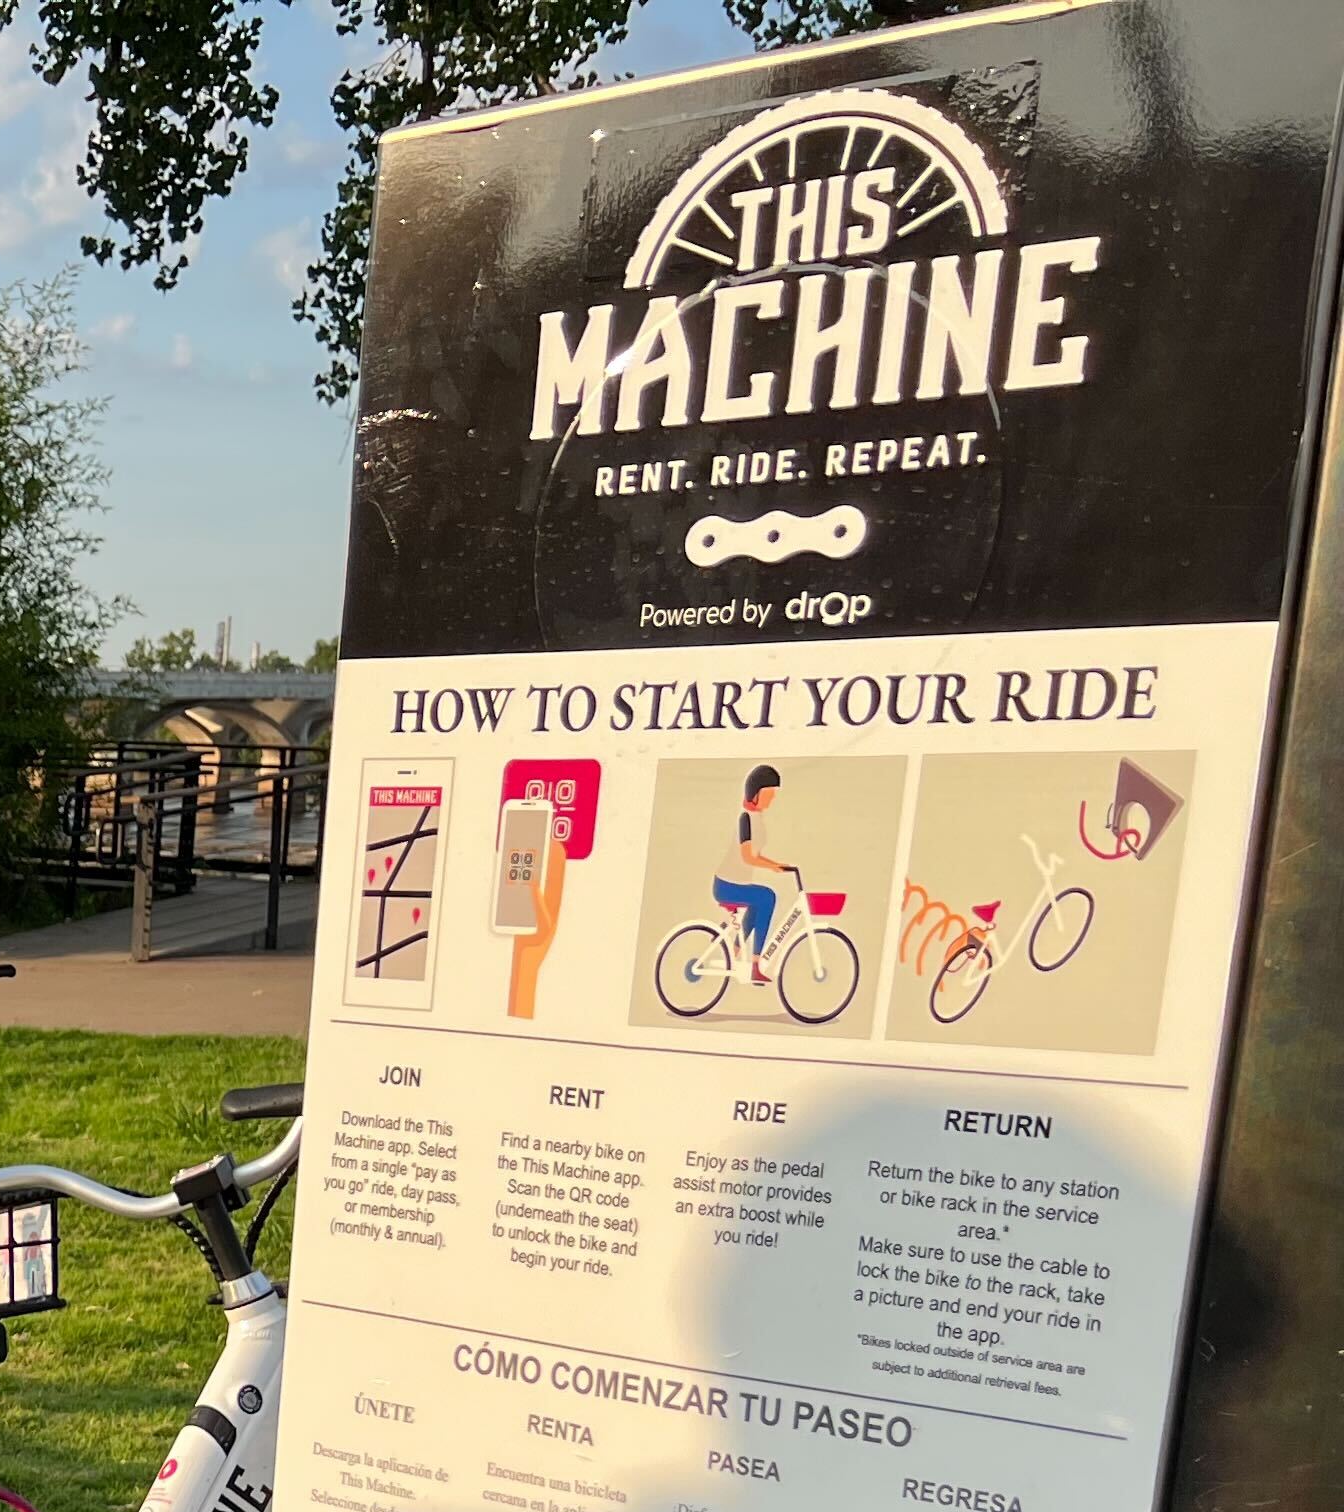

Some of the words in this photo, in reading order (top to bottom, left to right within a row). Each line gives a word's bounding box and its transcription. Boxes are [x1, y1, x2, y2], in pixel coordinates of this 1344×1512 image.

[730, 167, 897, 271] THIS
[529, 236, 1102, 441] MACHINE
[594, 458, 693, 497] RENT.
[710, 447, 807, 488] RIDE.
[824, 429, 987, 478] REPEAT.
[639, 597, 736, 630] Powered
[741, 597, 771, 629] by
[390, 687, 515, 733] HOW
[526, 684, 596, 732] TO
[610, 676, 789, 730] START
[802, 673, 975, 726] YOUR
[990, 666, 1157, 722] RIDE
[374, 789, 394, 803] THIS
[396, 789, 439, 804] MACHINE
[379, 1066, 421, 1087] JOIN
[549, 1085, 604, 1109] RENT
[733, 1100, 786, 1123] RIDE
[341, 1110, 400, 1130] Download
[404, 1118, 423, 1133] the
[427, 1119, 452, 1136] This
[944, 1109, 1052, 1138] RETURN
[334, 1131, 384, 1151] Machine
[387, 1141, 413, 1157] app.
[418, 1141, 456, 1159] Select
[501, 1132, 529, 1149] Find
[532, 1139, 540, 1150] a
[545, 1140, 592, 1160] nearby
[595, 1142, 624, 1160] bike
[627, 1150, 644, 1162] on
[331, 1153, 358, 1169] from
[360, 1160, 368, 1171] a
[372, 1159, 408, 1178] single
[411, 1162, 438, 1183] "pay
[441, 1170, 456, 1182] as
[498, 1155, 517, 1170] the
[521, 1157, 548, 1175] This
[553, 1161, 610, 1182] Machine
[613, 1172, 643, 1189] app.
[686, 1150, 727, 1172] Enjoy
[731, 1158, 748, 1171] as
[754, 1157, 776, 1173] the
[781, 1162, 824, 1178] pedal
[324, 1177, 345, 1191] you
[348, 1178, 368, 1195] go"
[371, 1181, 397, 1198] ride,
[401, 1184, 424, 1203] day
[426, 1190, 459, 1206] pass,
[507, 1178, 540, 1196] Scan
[545, 1184, 565, 1200] the
[569, 1186, 592, 1203] QR
[596, 1192, 629, 1208] code
[673, 1177, 715, 1192] assist
[719, 1181, 763, 1197] motor
[766, 1185, 832, 1203] provides
[868, 1160, 922, 1181] Return
[928, 1167, 954, 1184] the
[960, 1169, 995, 1188] bike
[1001, 1173, 1016, 1190] to
[1022, 1179, 1054, 1196] any
[1059, 1180, 1119, 1199] station
[344, 1201, 358, 1213] or
[360, 1203, 434, 1226] membership
[496, 1200, 574, 1224] (underneath
[578, 1211, 600, 1227] the
[603, 1217, 638, 1237] seat)
[675, 1201, 693, 1214] an
[698, 1202, 734, 1218] extra
[739, 1204, 781, 1223] boost
[785, 1210, 824, 1228] while
[880, 1191, 897, 1203] or
[901, 1189, 935, 1208] bike
[941, 1195, 976, 1212] rack
[982, 1202, 996, 1214] in
[1003, 1200, 1030, 1217] the
[1035, 1206, 1098, 1224] service
[330, 1218, 381, 1241] (monthly
[384, 1225, 392, 1239] &
[396, 1230, 446, 1250] annual).
[492, 1223, 504, 1237] to
[508, 1226, 550, 1244] unlock
[554, 1231, 575, 1247] the
[579, 1234, 607, 1252] bike
[611, 1241, 637, 1256] and
[714, 1230, 740, 1245] you
[745, 1230, 778, 1247] ride!
[510, 1247, 546, 1268] begin
[549, 1256, 580, 1271] your
[583, 1258, 612, 1276] ride.
[859, 1236, 902, 1255] Make
[907, 1245, 944, 1260] sure
[950, 1246, 965, 1262] to
[971, 1252, 1001, 1266] use
[1008, 1253, 1034, 1270] the
[1040, 1258, 1087, 1276] cable
[1094, 1263, 1110, 1279] to
[857, 1261, 889, 1279] lock
[894, 1265, 920, 1283] the
[925, 1268, 959, 1288] bike
[965, 1274, 981, 1290] to
[987, 1276, 1013, 1294] the
[1019, 1283, 1060, 1303] rack,
[1068, 1286, 1104, 1305] take
[854, 1289, 863, 1301] a
[868, 1290, 923, 1309] picture
[929, 1298, 961, 1313] and
[966, 1302, 998, 1318] end
[1002, 1308, 1042, 1324] your
[1047, 1310, 1080, 1329] ride
[1086, 1314, 1100, 1331] in
[937, 1321, 962, 1339] the
[968, 1329, 1003, 1347] app.
[354, 1392, 414, 1423] ÚNETE
[454, 1341, 541, 1385] CÓMO
[551, 1361, 728, 1419] COMENZAR
[739, 1392, 781, 1426] TU
[793, 1401, 912, 1447] PASEO
[527, 1414, 593, 1446] RENTA
[708, 1451, 780, 1482] PASEA
